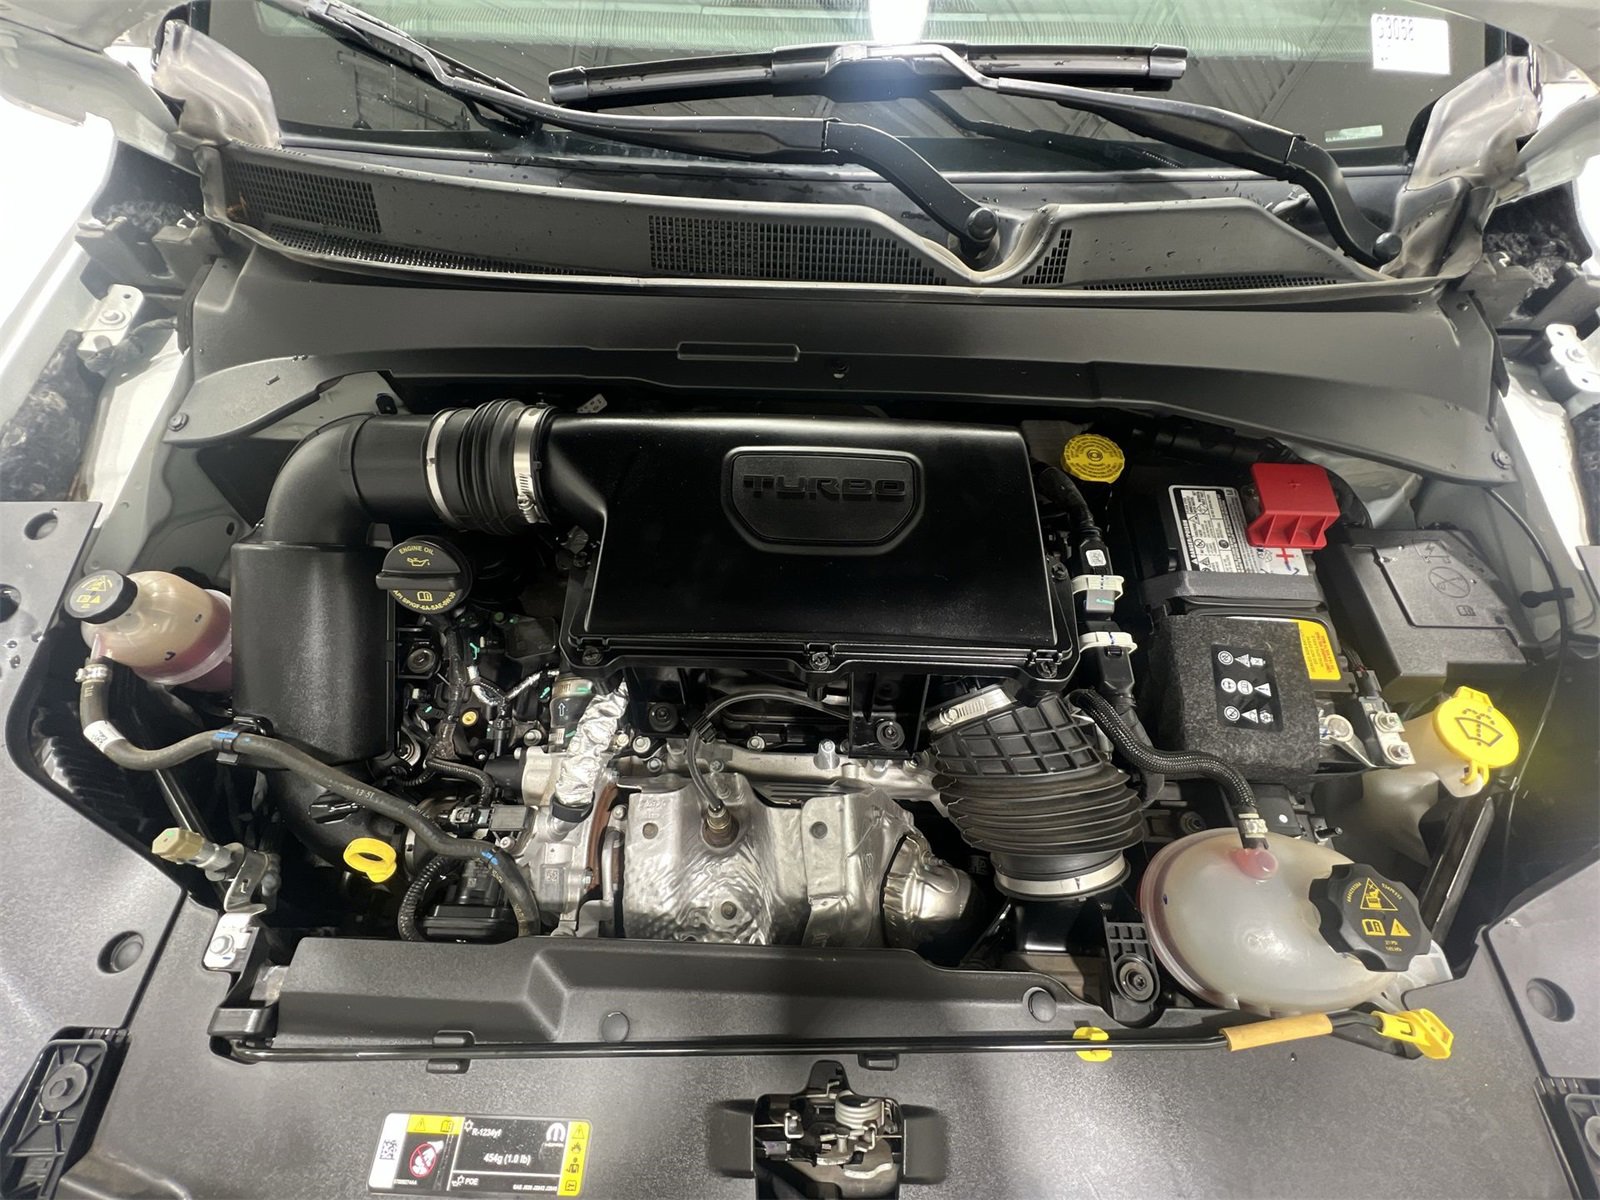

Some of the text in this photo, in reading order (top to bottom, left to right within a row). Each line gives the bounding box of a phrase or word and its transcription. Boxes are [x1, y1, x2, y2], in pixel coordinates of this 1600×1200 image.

[743, 474, 906, 501] TURBO
[399, 545, 434, 555] ENGINE OIL
[393, 590, 403, 599] API
[472, 1128, 502, 1138] R-1234yf
[483, 1153, 531, 1166] 454g (1.0 lb)
[465, 1177, 479, 1185] POE
